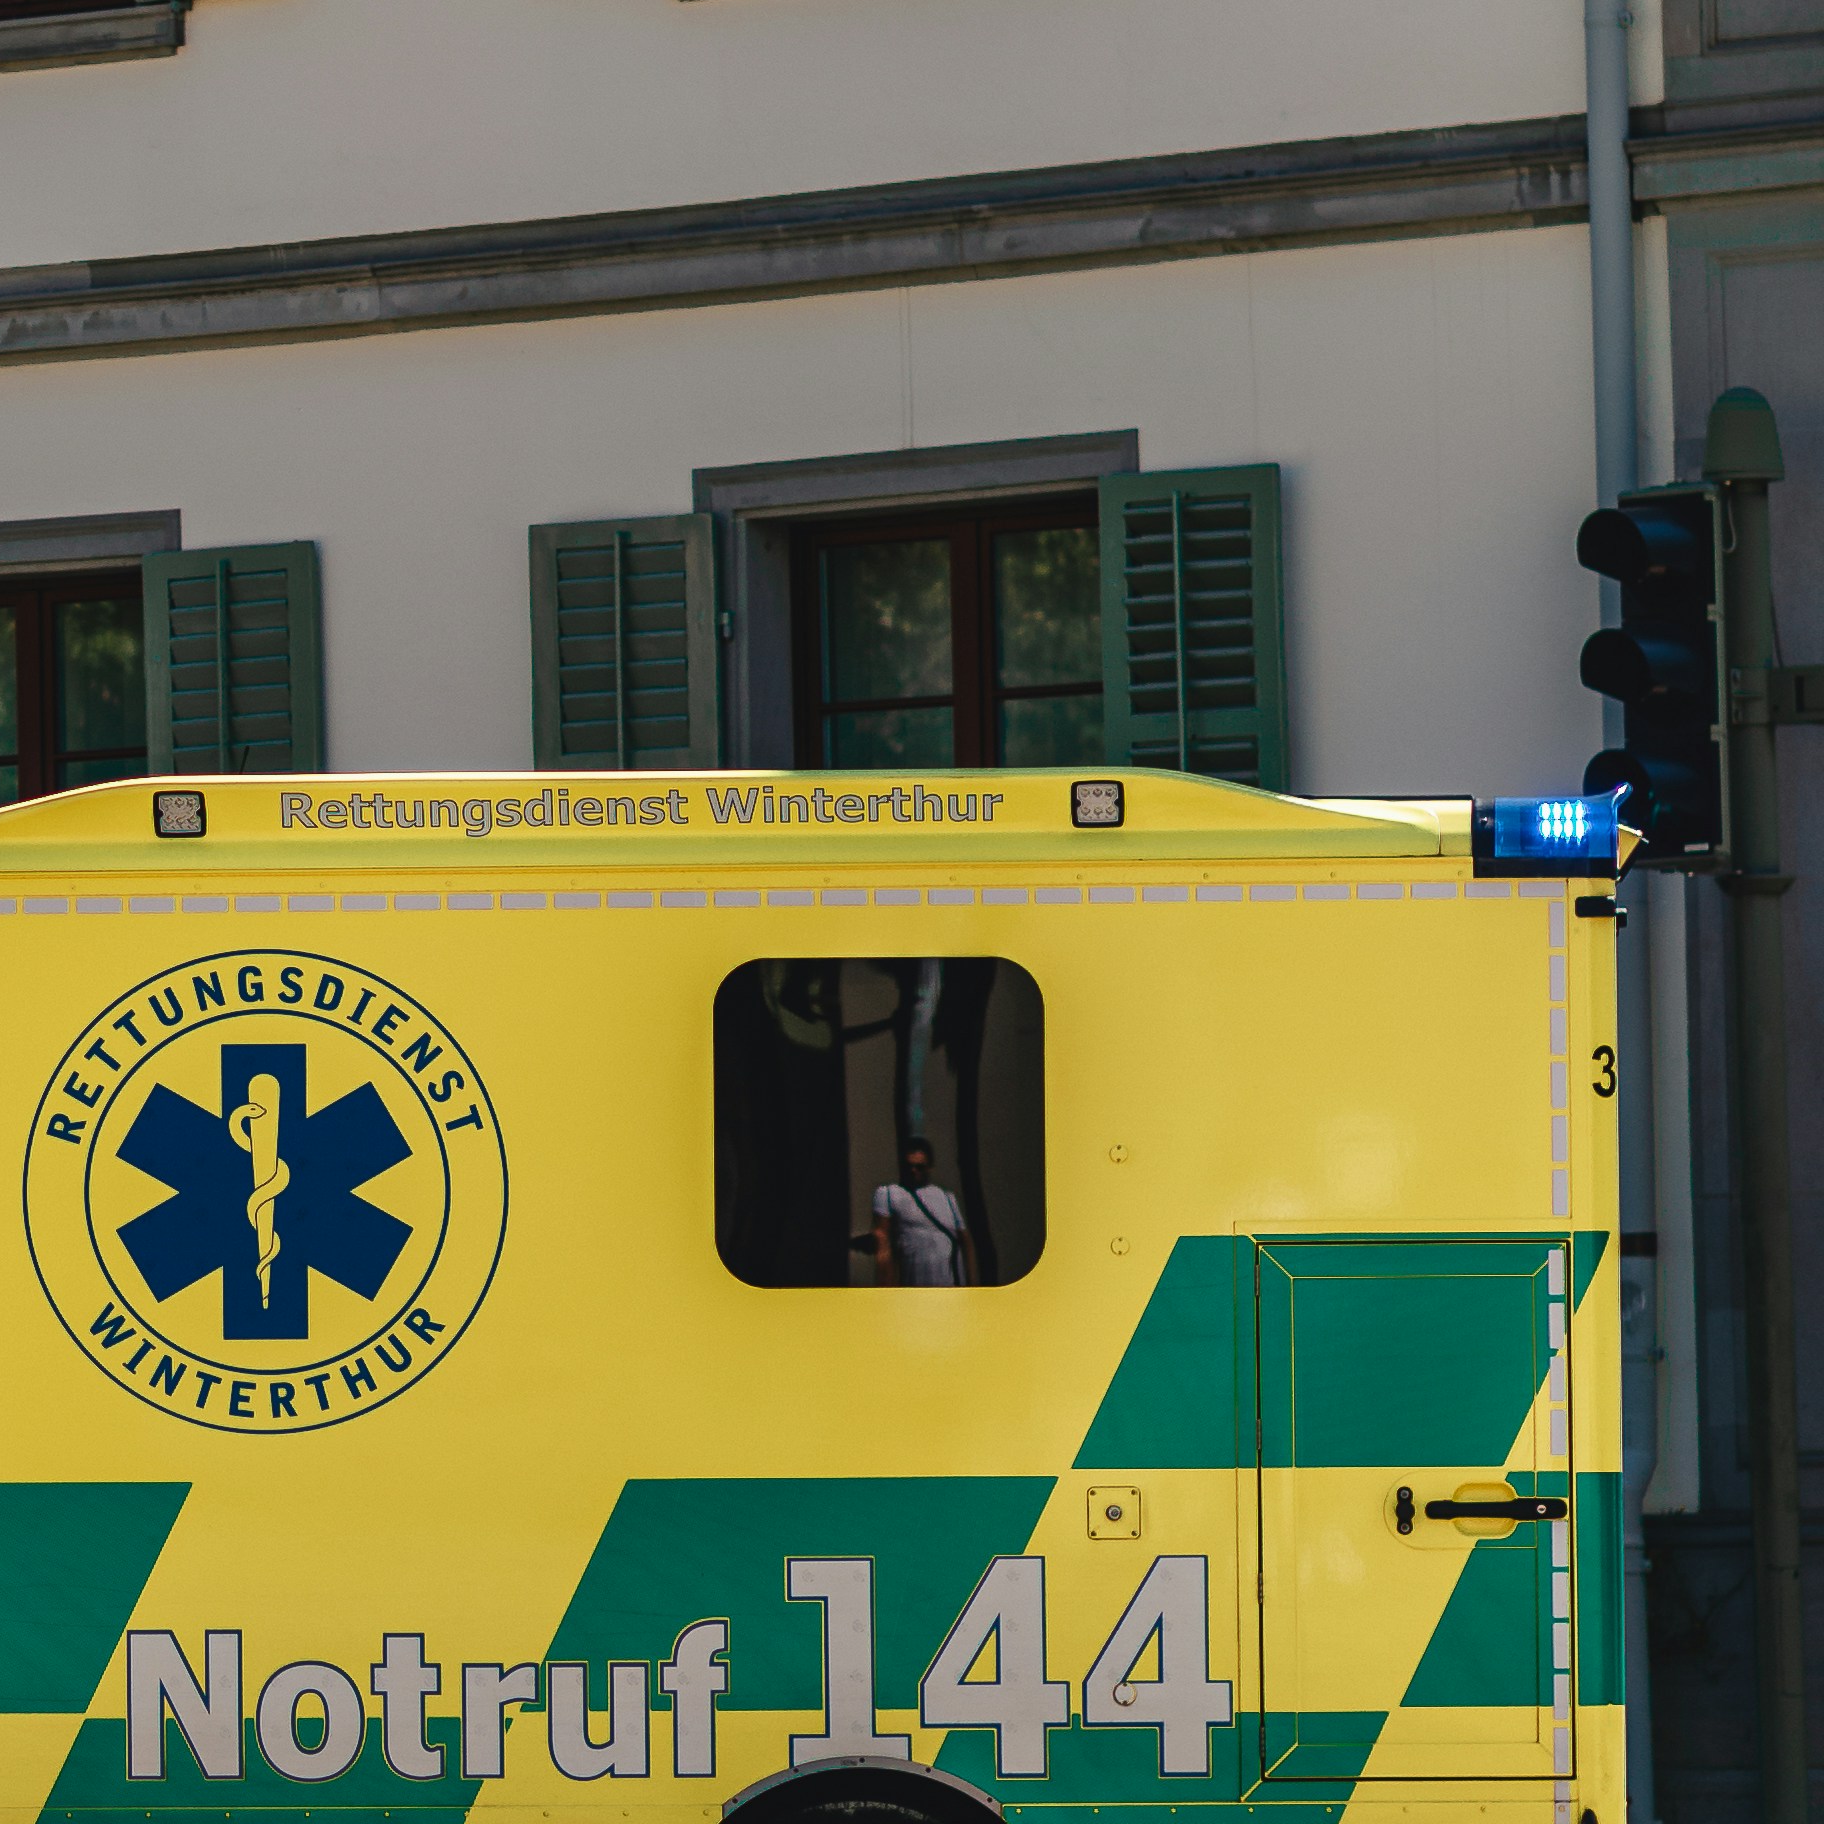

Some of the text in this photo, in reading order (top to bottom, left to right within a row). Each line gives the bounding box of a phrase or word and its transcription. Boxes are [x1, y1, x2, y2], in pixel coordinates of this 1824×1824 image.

[280, 784, 1004, 837] Rettungsdienst Winterthur
[45, 964, 484, 1145] RETTUNGSDIENST
[1591, 1044, 1616, 1099] 3
[88, 1300, 446, 1419] WINTERTHUR
[125, 1554, 1235, 1781] Notruf 144
